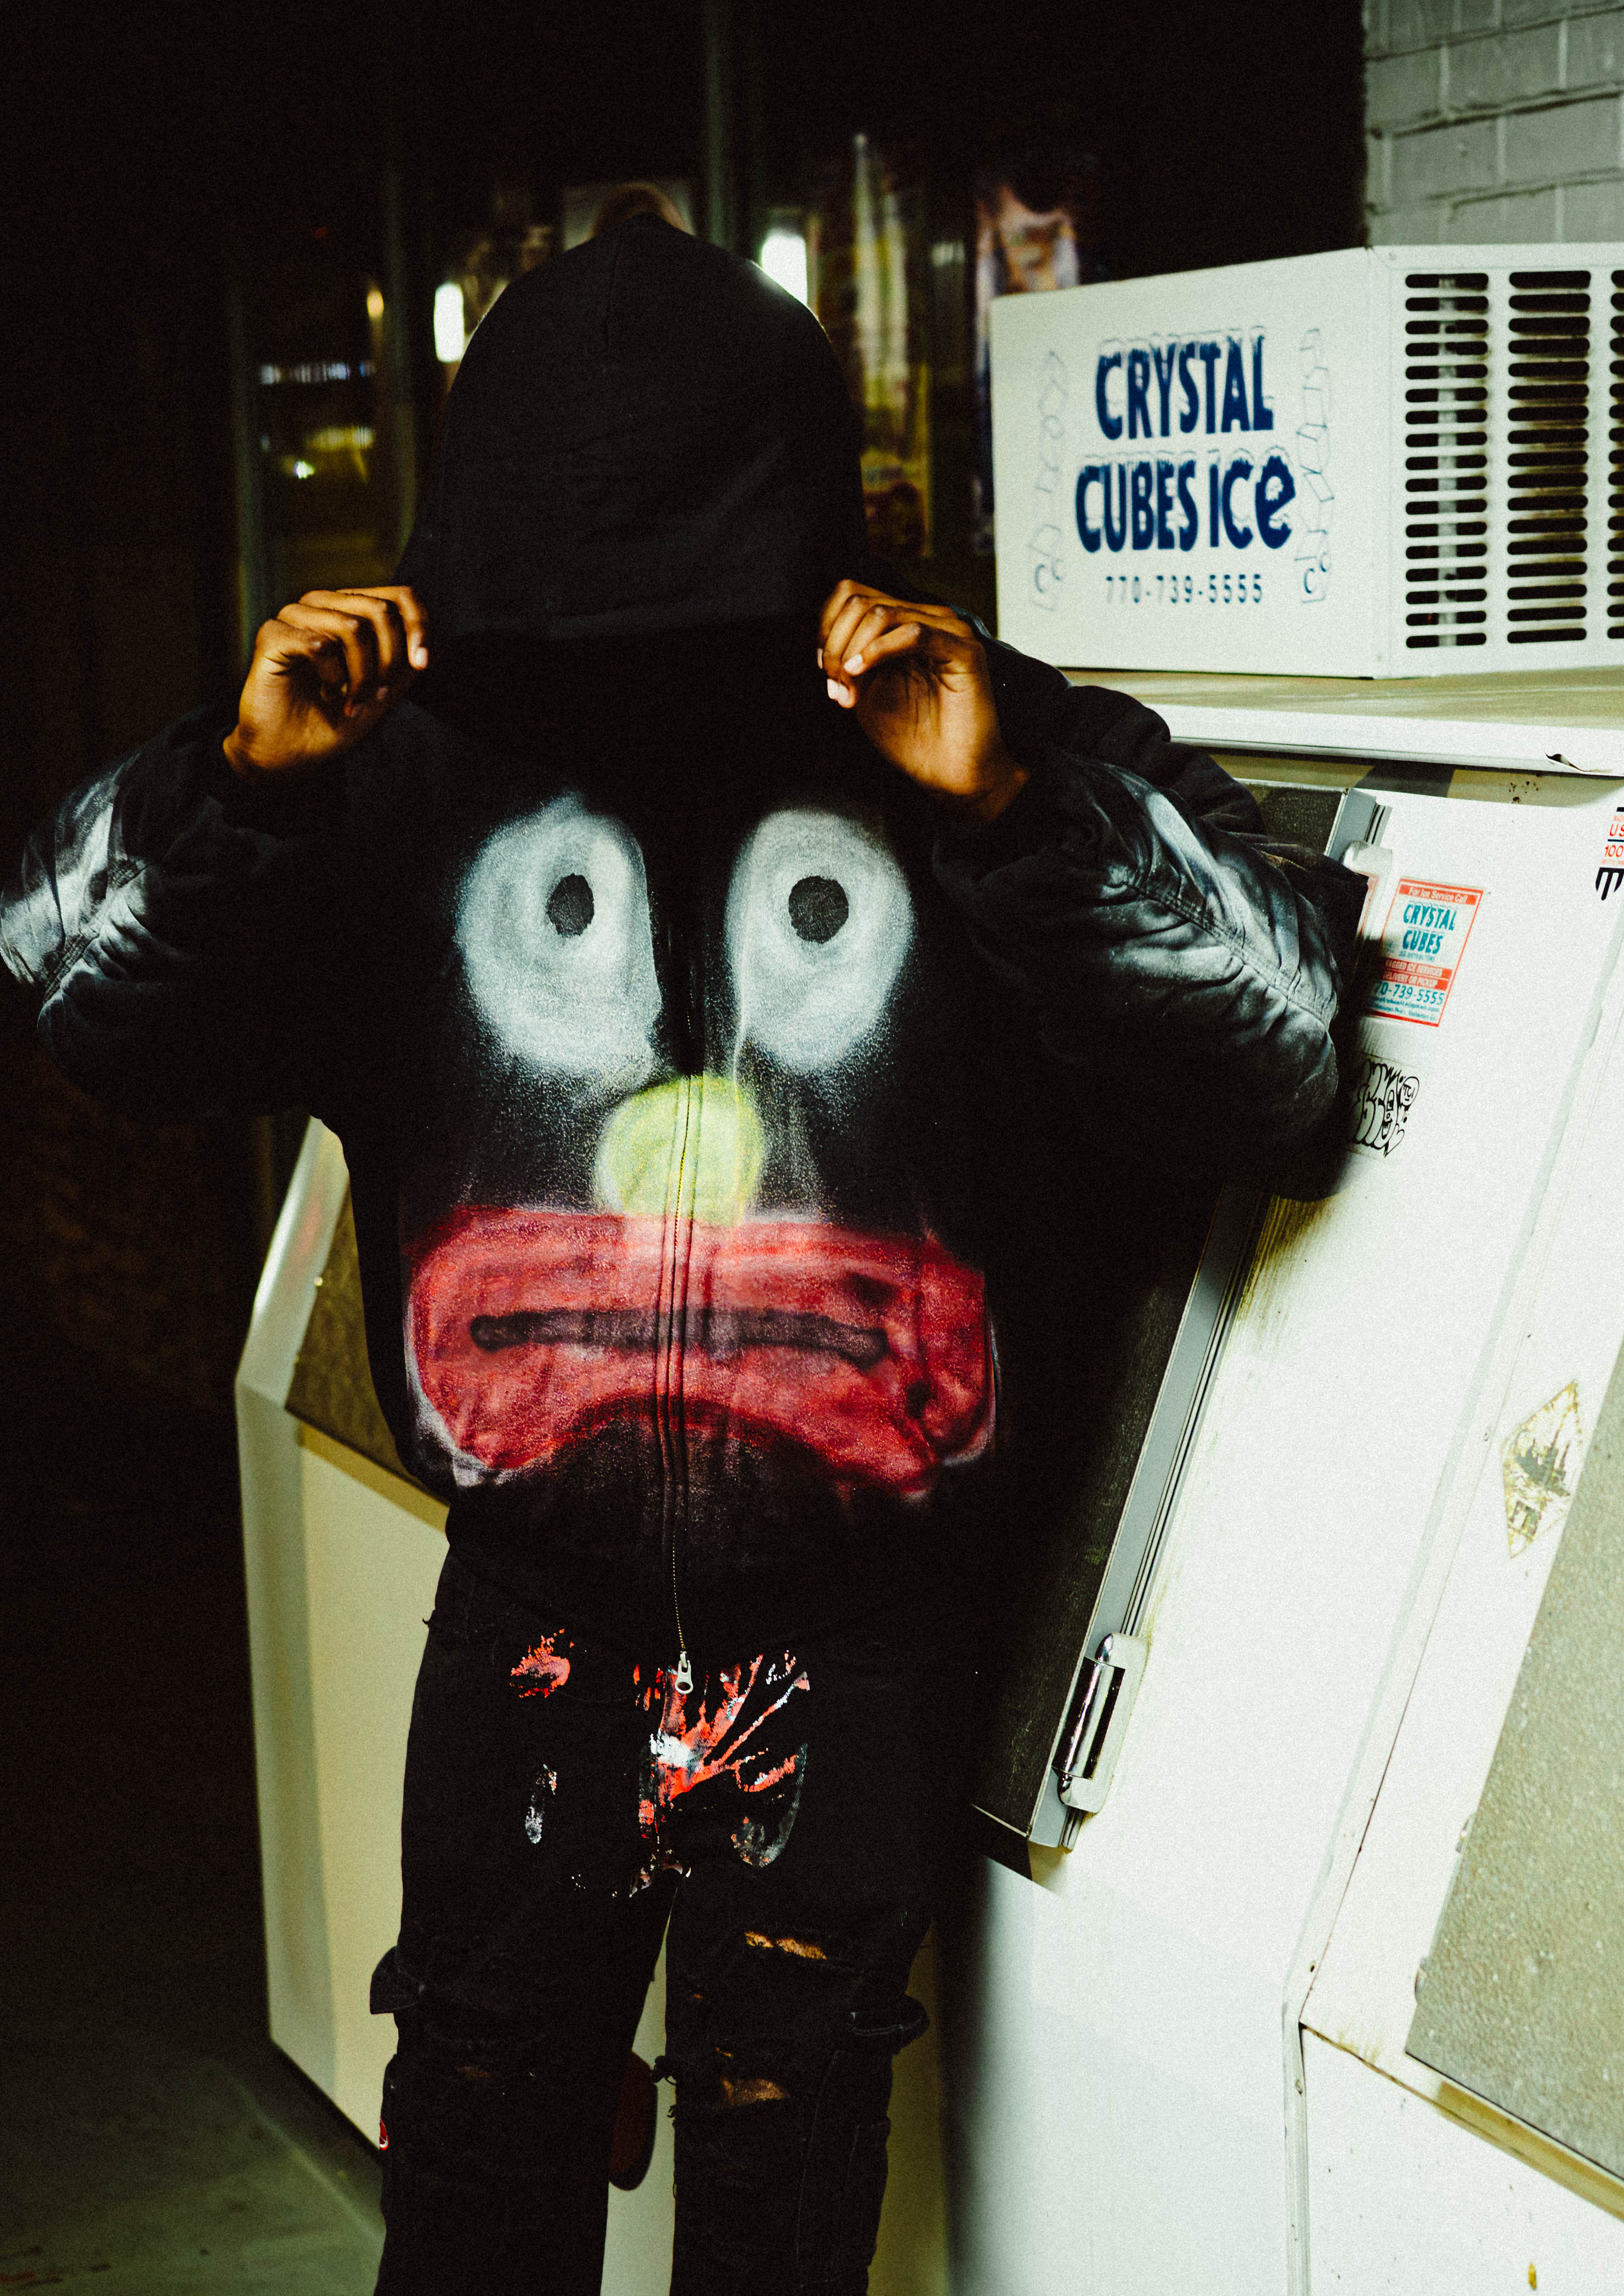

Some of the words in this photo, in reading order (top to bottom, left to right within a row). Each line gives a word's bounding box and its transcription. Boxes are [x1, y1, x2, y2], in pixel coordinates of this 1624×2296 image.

[1097, 332, 1274, 440] CRYSTAL
[1076, 459, 1199, 553] CUBES
[1408, 887, 1421, 895] For
[1421, 889, 1431, 897] Ice
[1431, 890, 1455, 901] Service
[1455, 894, 1468, 904] Call
[1403, 903, 1457, 931] CRYSTAL
[1402, 930, 1444, 954] CUBES
